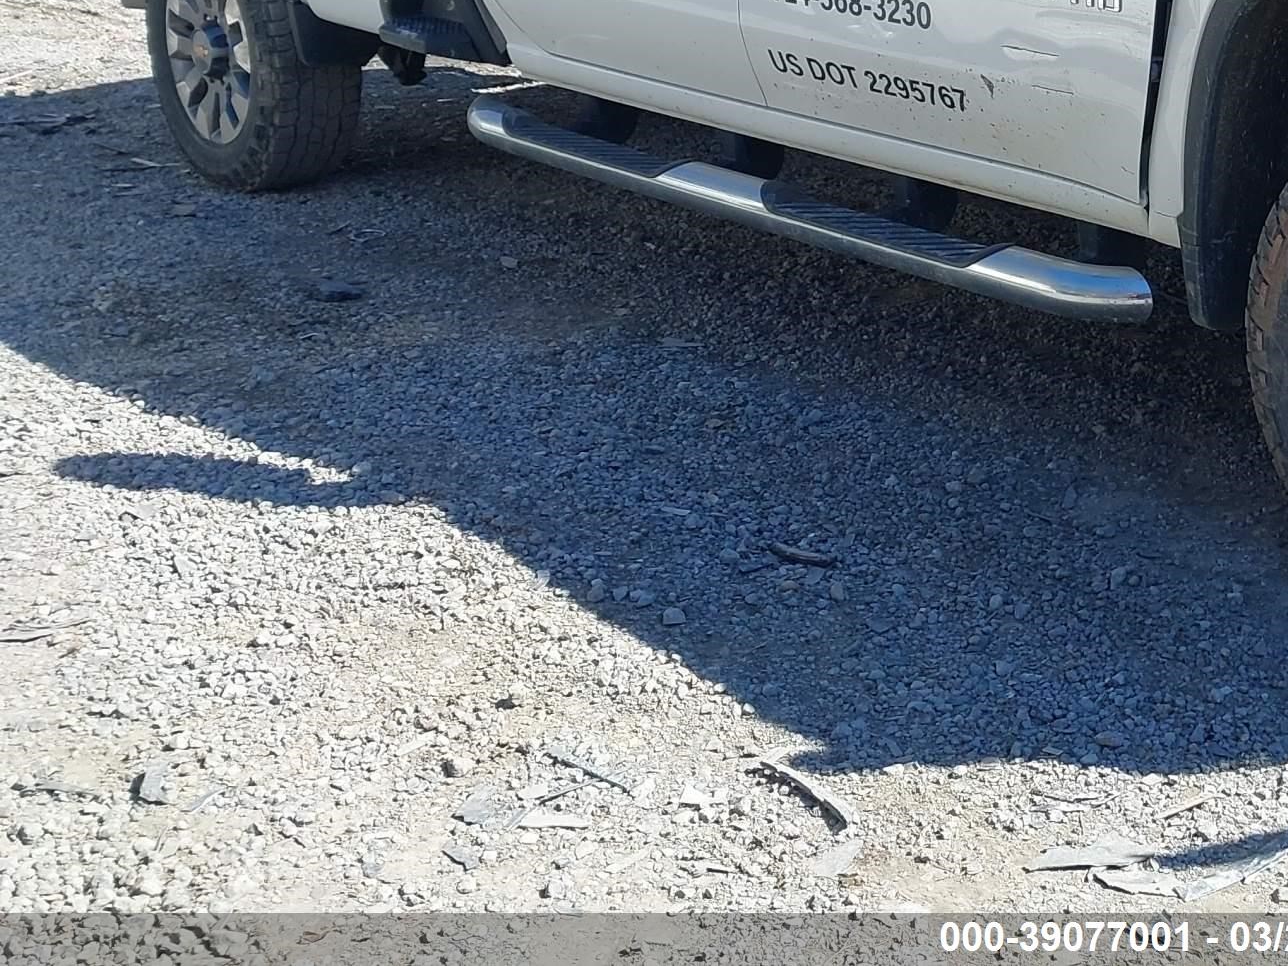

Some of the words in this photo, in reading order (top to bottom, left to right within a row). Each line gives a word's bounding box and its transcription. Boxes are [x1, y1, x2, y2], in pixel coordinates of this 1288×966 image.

[767, 48, 804, 77] US
[805, 57, 858, 89] DOT
[863, 69, 968, 113] 2295767
